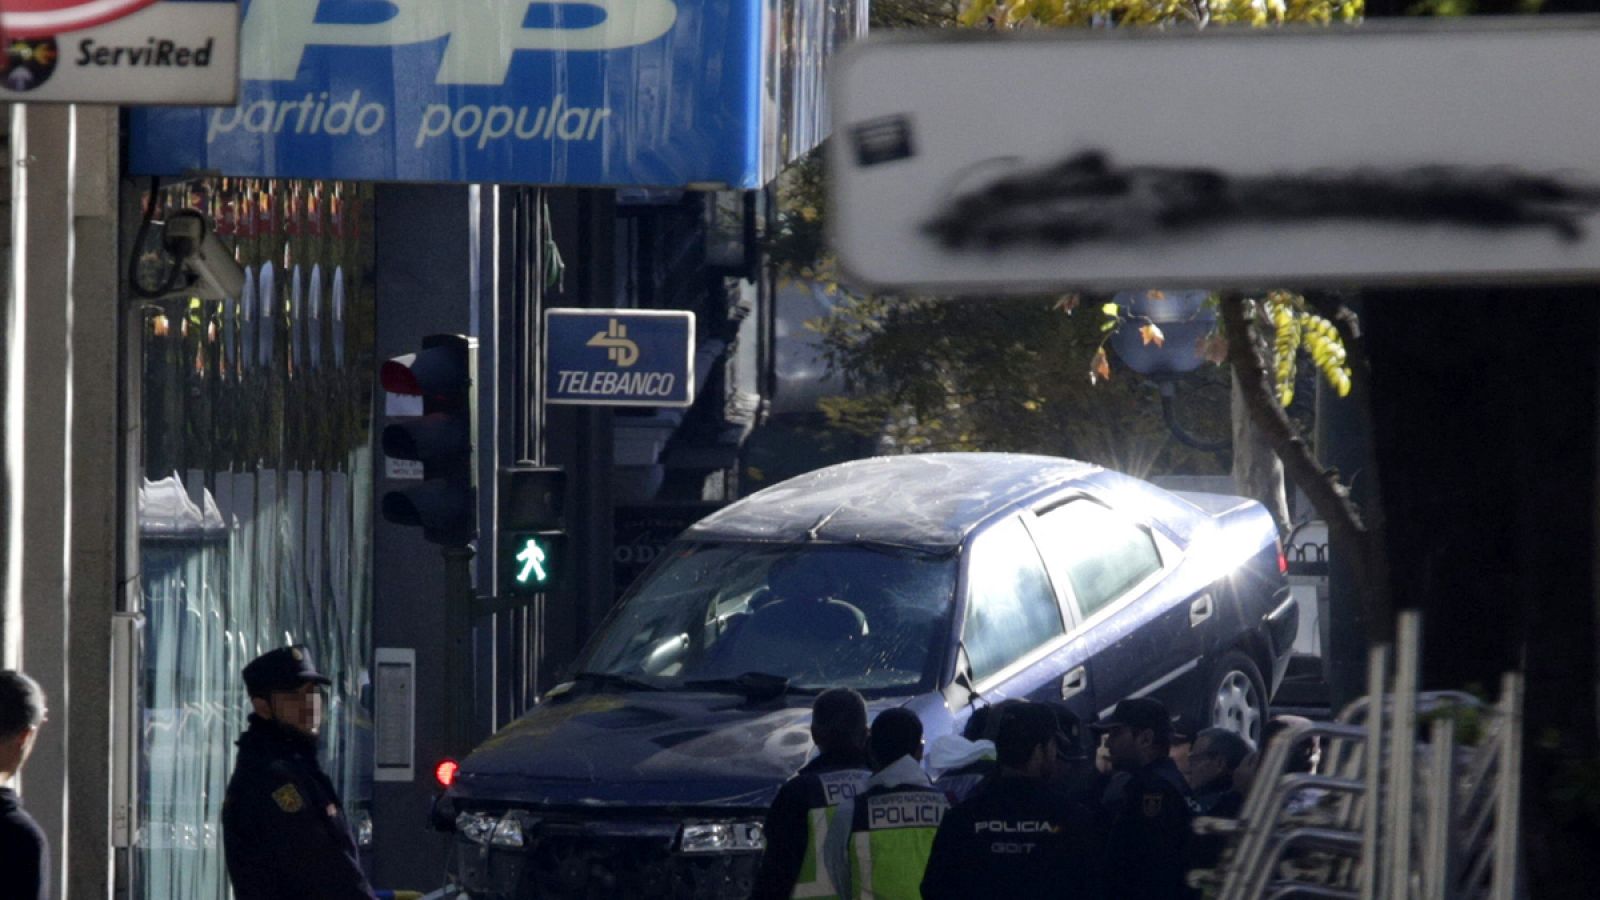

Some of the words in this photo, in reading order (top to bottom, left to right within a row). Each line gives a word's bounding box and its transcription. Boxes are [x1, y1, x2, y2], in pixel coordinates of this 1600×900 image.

[76, 37, 213, 67] ServiRed
[208, 90, 385, 143] partido
[415, 95, 610, 149] popular
[558, 371, 676, 396] TELEBANCO
[871, 805, 945, 824] POLICI
[974, 820, 1052, 834] POLICIA
